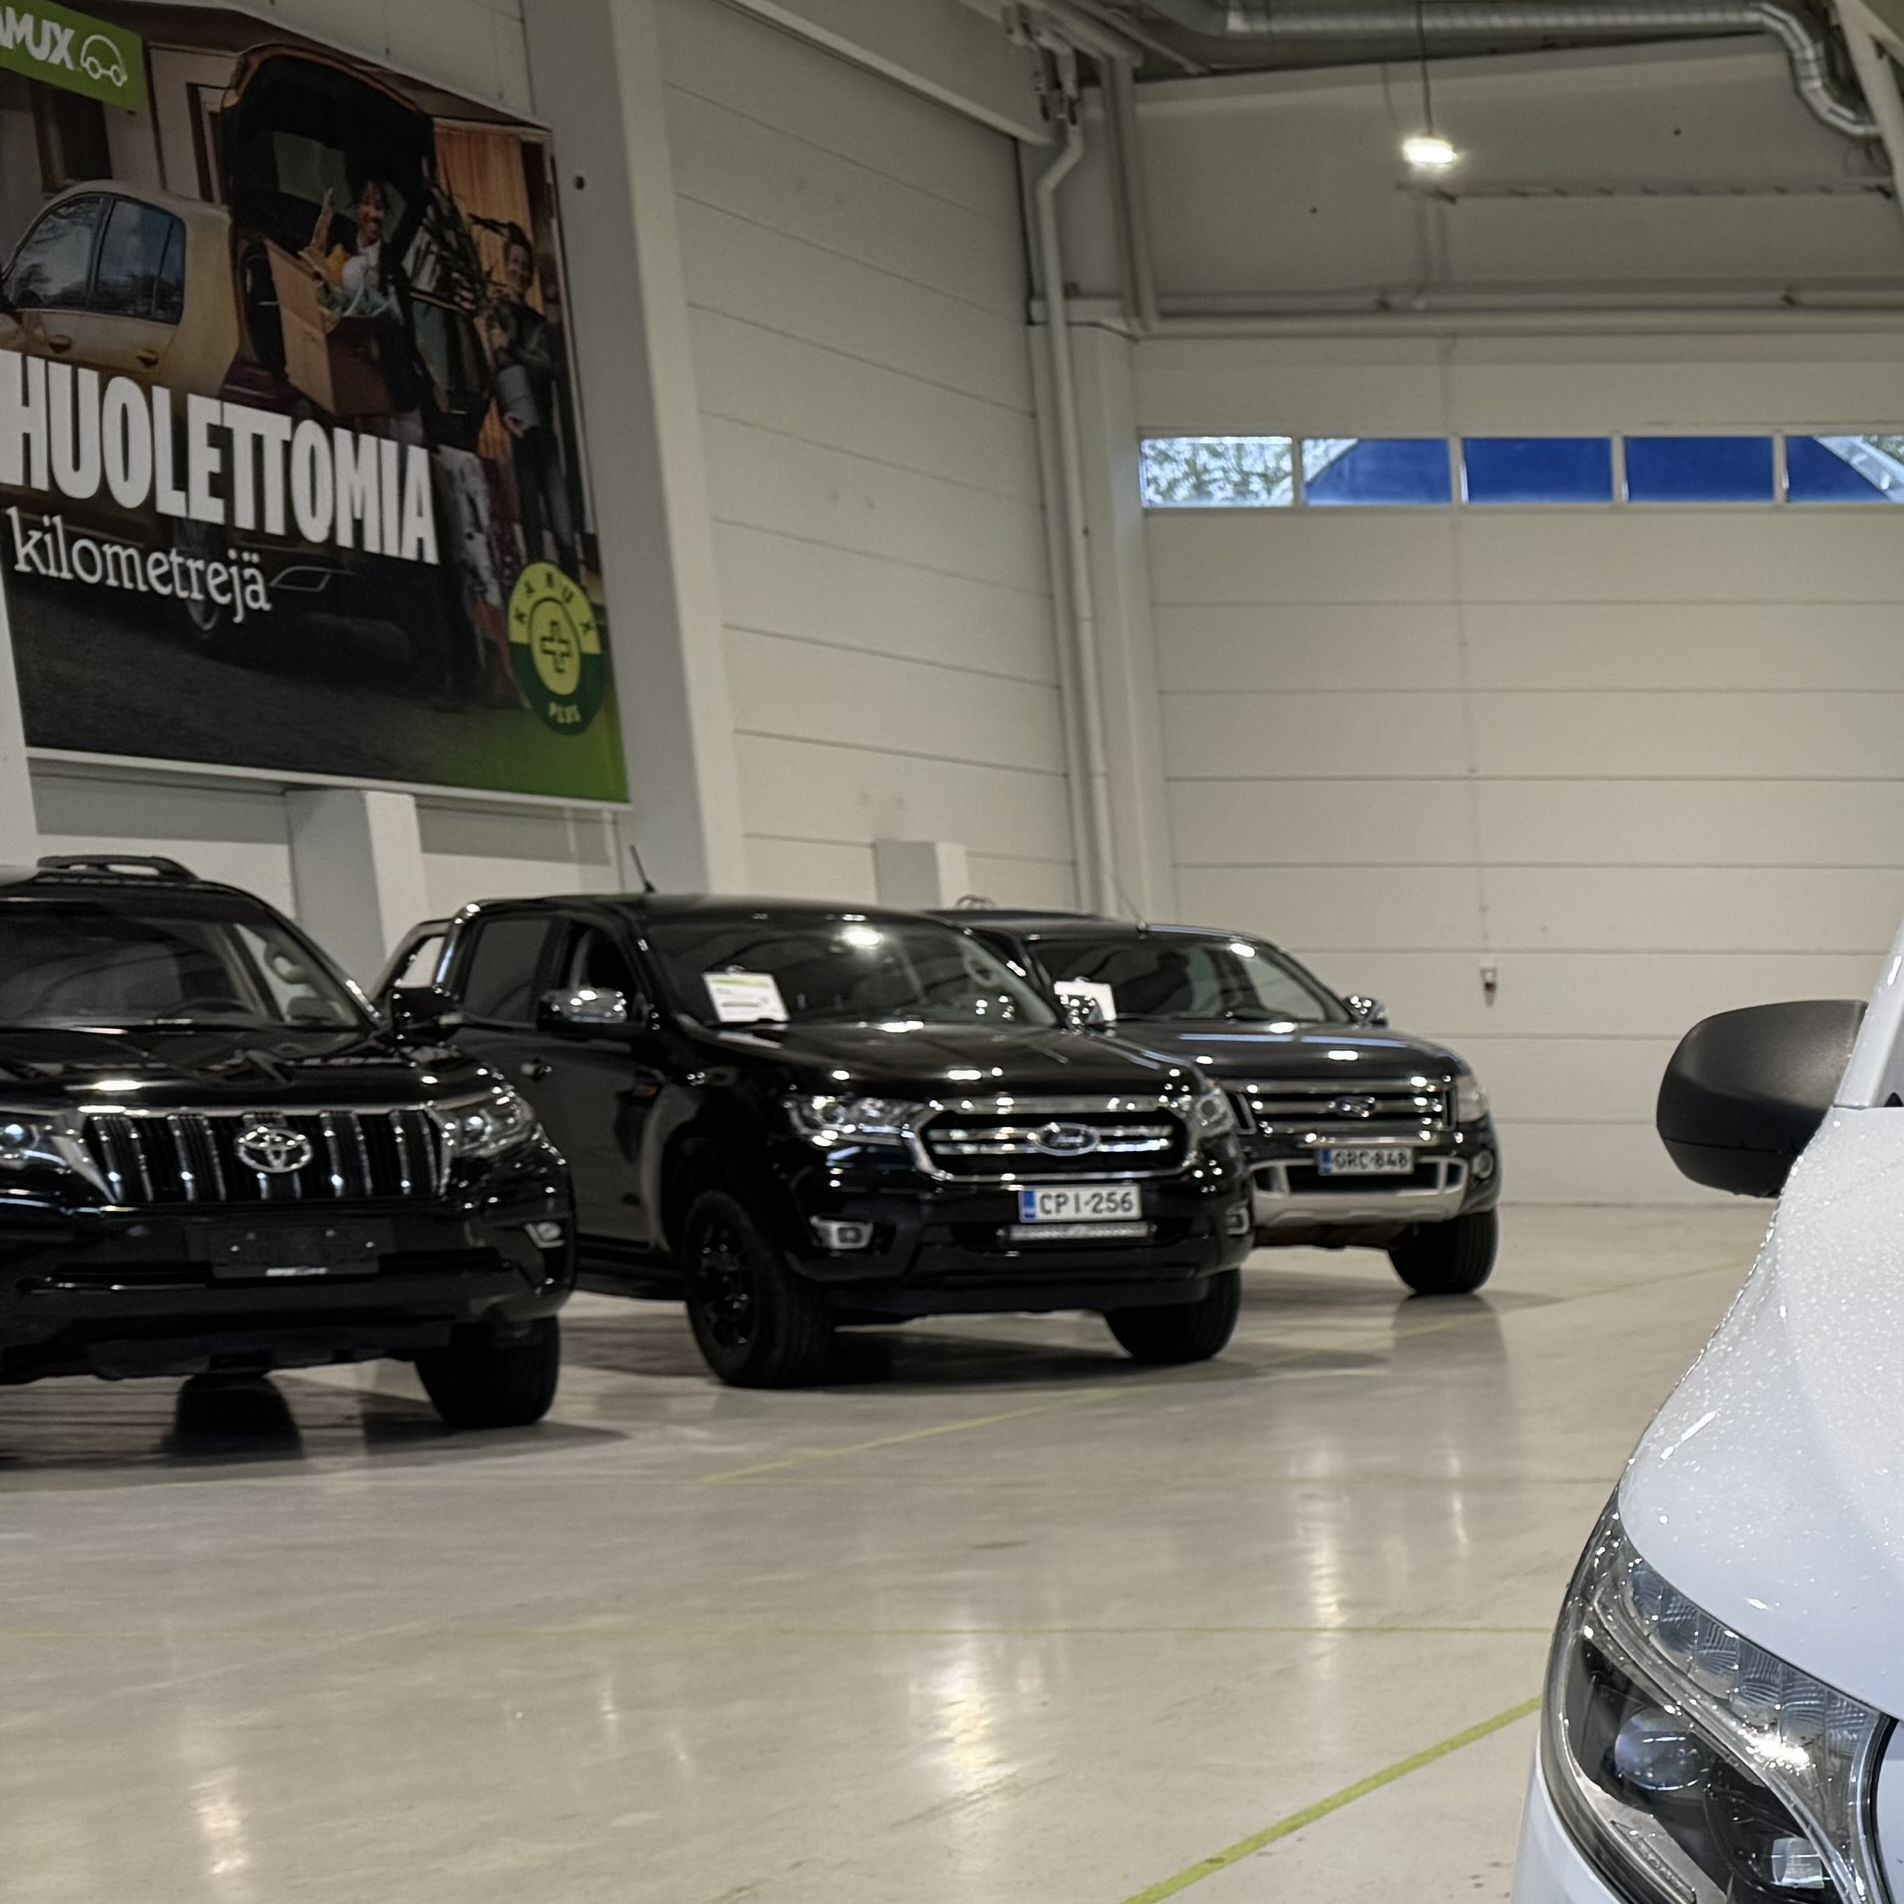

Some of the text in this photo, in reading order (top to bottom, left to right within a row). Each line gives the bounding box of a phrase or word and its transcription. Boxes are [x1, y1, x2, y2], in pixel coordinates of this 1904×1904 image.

[0, 348, 440, 566] HUOLETTOMIA
[6, 506, 271, 623] kilometrejä
[1039, 1192, 1133, 1215] CPI-256
